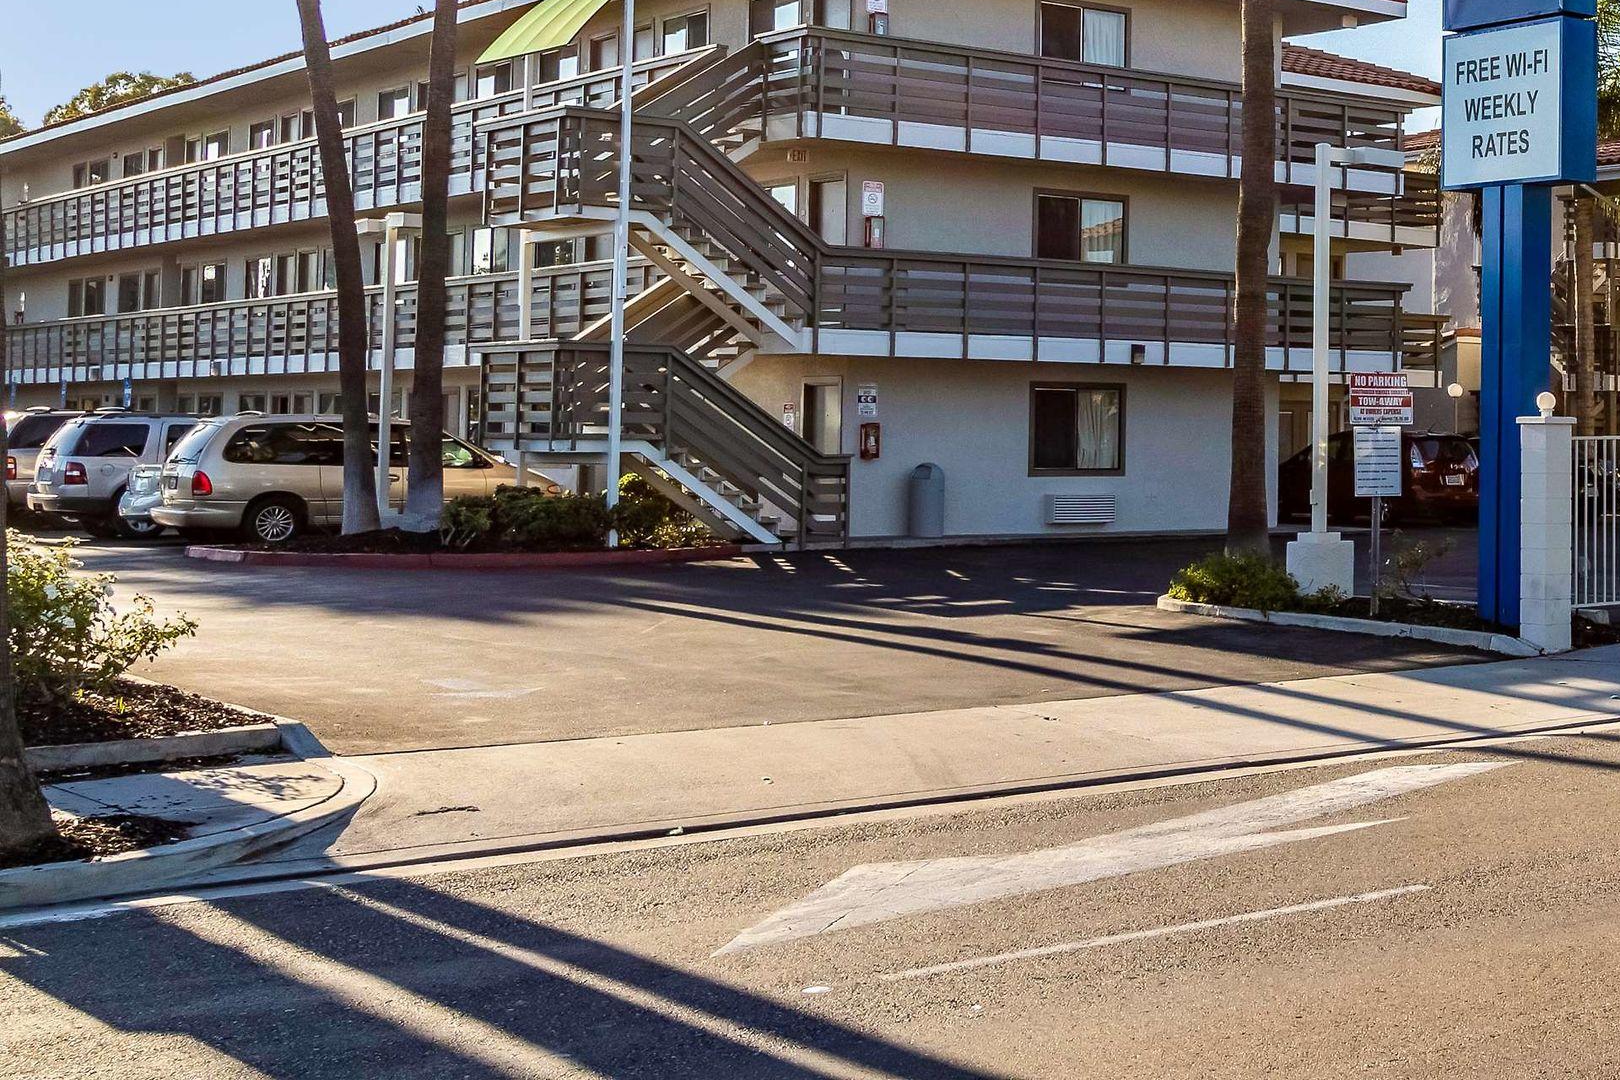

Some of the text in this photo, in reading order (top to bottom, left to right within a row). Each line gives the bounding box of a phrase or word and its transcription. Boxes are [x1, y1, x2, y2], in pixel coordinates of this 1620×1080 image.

[1456, 49, 1548, 85] FREE WI-FI
[1464, 89, 1539, 122] WEEKLY
[1472, 129, 1530, 159] RATES
[1355, 375, 1407, 387] NO PARKING
[1358, 396, 1403, 406] TOW-AWAY
